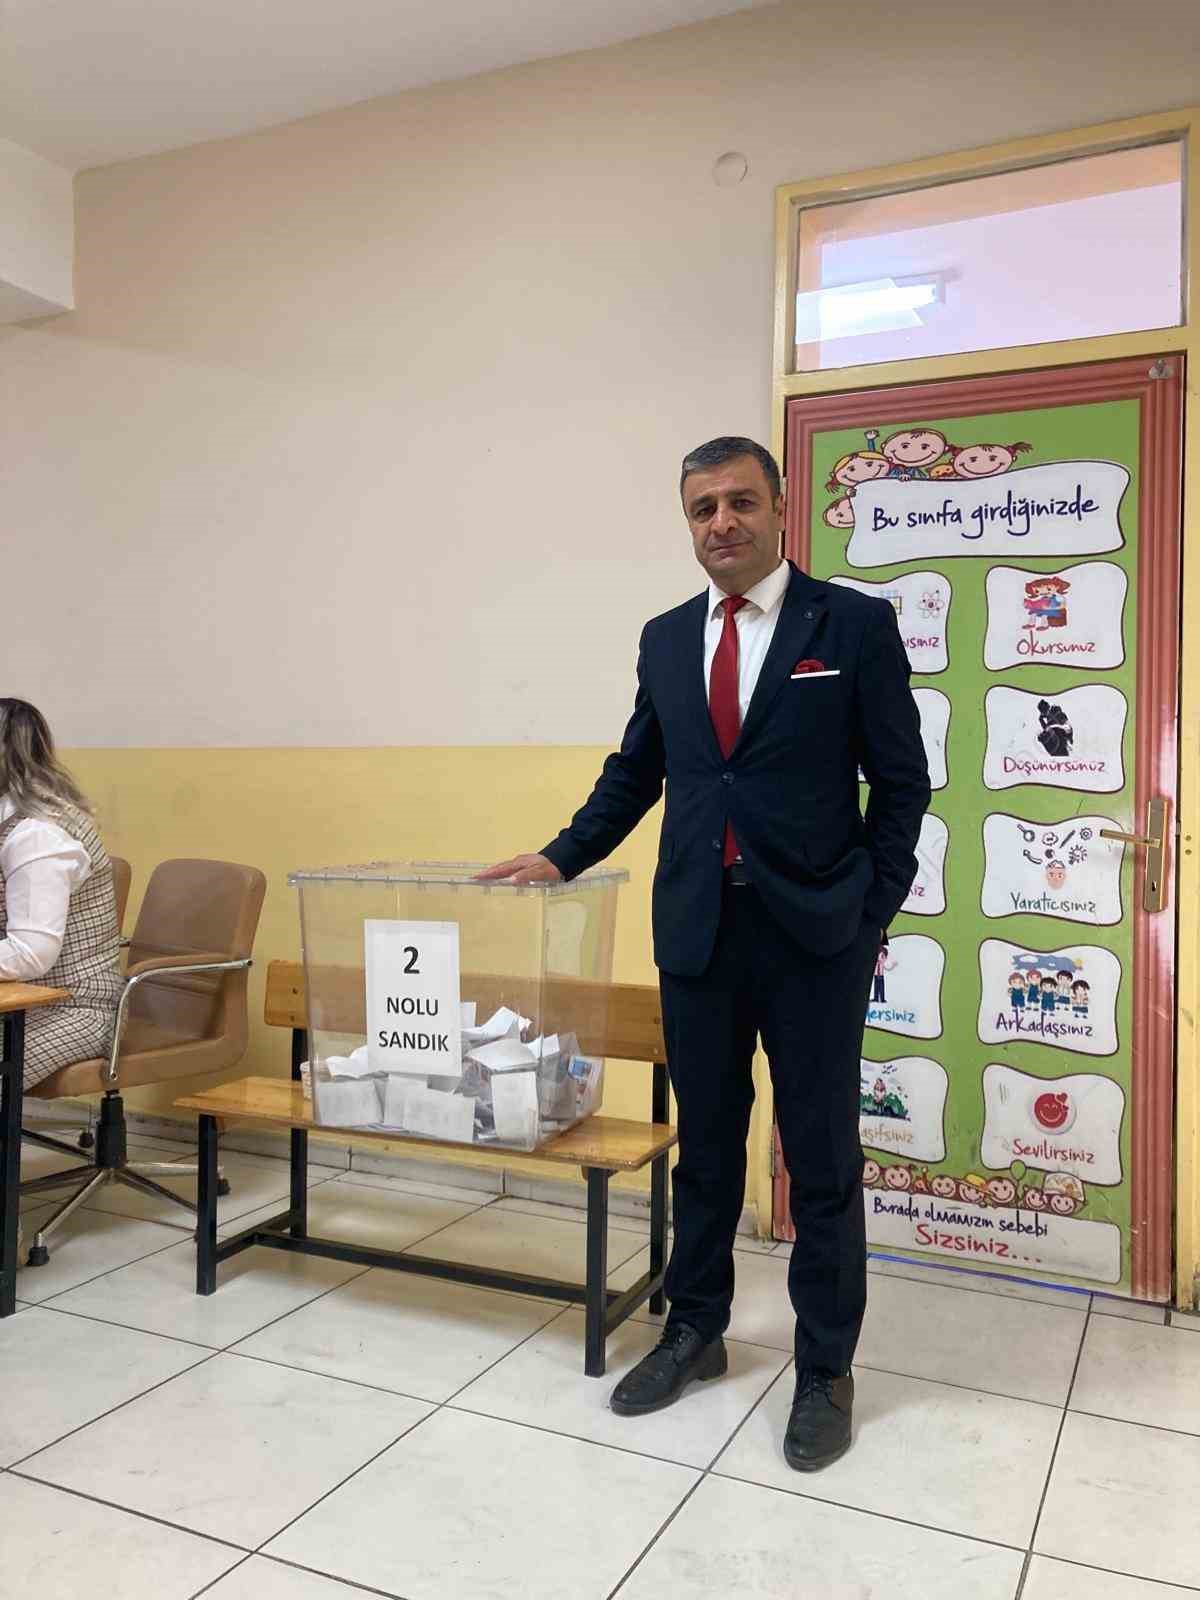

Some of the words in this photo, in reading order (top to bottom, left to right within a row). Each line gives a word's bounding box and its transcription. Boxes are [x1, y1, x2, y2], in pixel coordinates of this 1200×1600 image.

[872, 506, 899, 531] Bu
[907, 500, 962, 528] sınıfa
[961, 484, 1099, 539] girdiğinizde
[1016, 631, 1096, 656] Okursunuz
[403, 946, 420, 975] 2
[386, 997, 439, 1017] NOLU
[995, 1008, 1094, 1039] Arkadaşsınız
[378, 1030, 449, 1052] SANDIK
[1012, 1138, 1096, 1165] Sevilirsiniz
[873, 1196, 920, 1222] Burada
[924, 1202, 995, 1229] olmamızın
[999, 1210, 1049, 1238] sebebi
